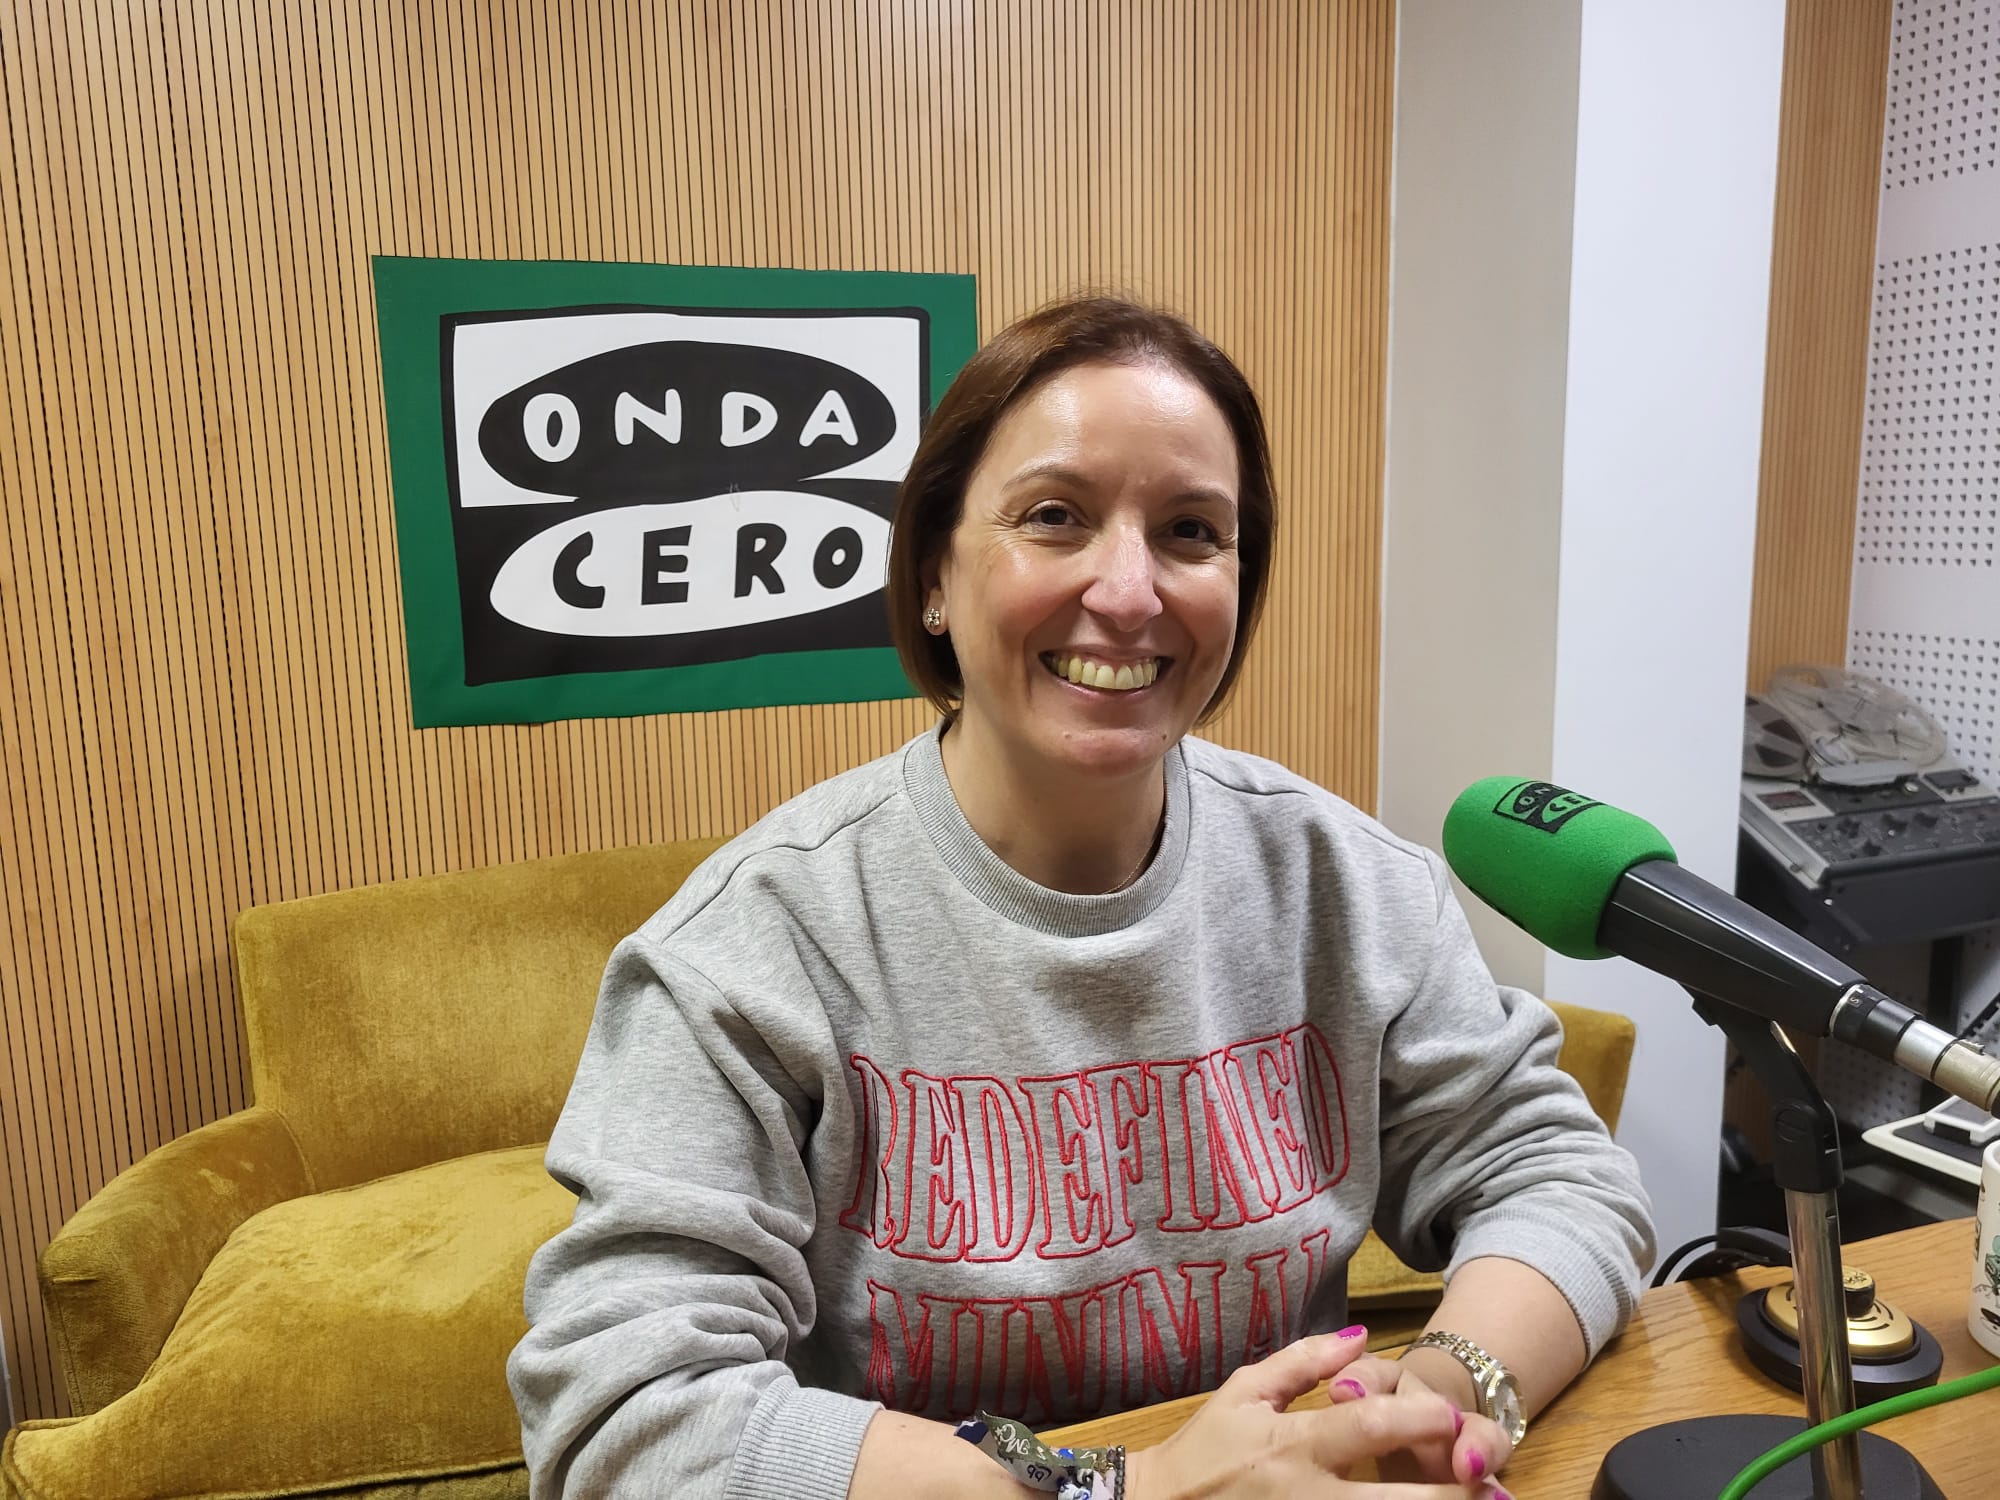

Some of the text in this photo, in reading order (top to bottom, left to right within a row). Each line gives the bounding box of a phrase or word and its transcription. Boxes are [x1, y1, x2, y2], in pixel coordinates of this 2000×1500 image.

[523, 388, 859, 463] ONDA
[552, 522, 864, 610] CERO
[839, 1022, 1350, 1263] REDEFINED
